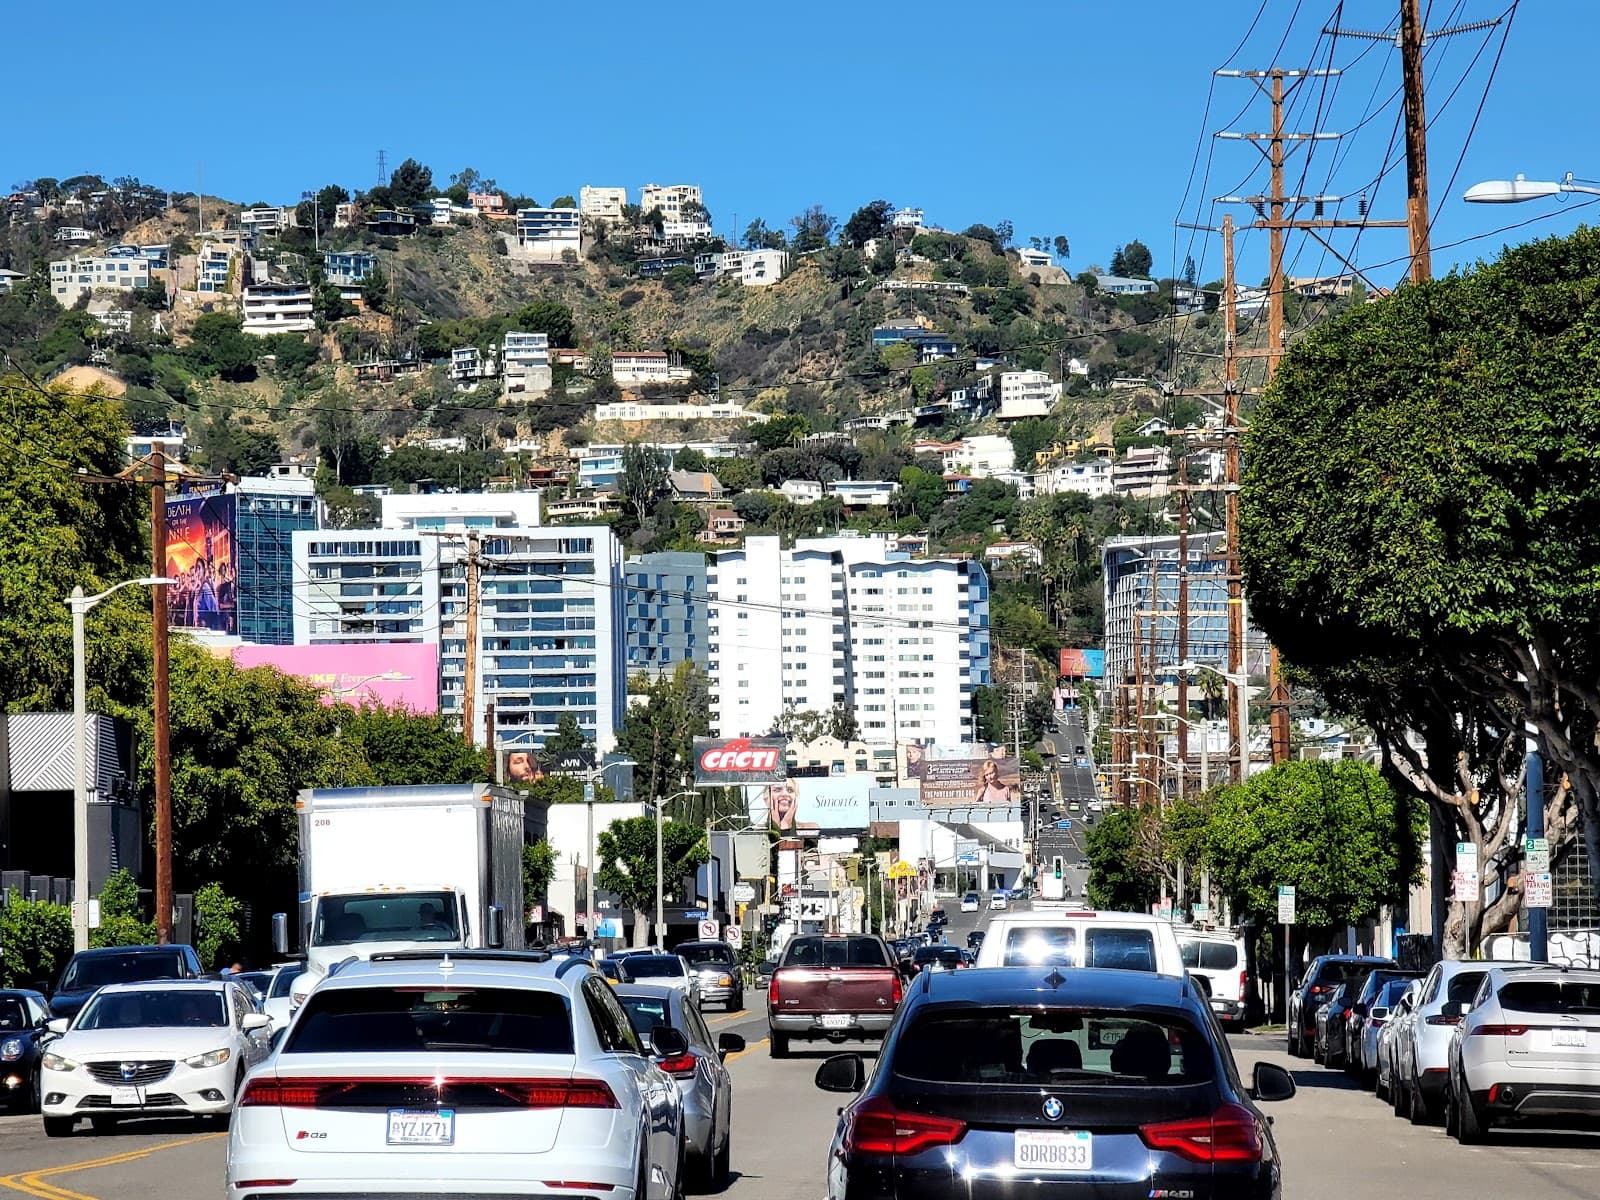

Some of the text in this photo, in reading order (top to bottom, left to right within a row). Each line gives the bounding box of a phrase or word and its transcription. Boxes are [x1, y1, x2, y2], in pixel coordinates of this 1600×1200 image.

[167, 504, 192, 517] DEATH
[168, 526, 190, 541] NILE
[560, 759, 580, 767] JVN
[703, 751, 776, 768] CACTI
[814, 795, 846, 808] Simon
[1527, 840, 1534, 849] 2
[1020, 1144, 1086, 1164] 8DRB833
